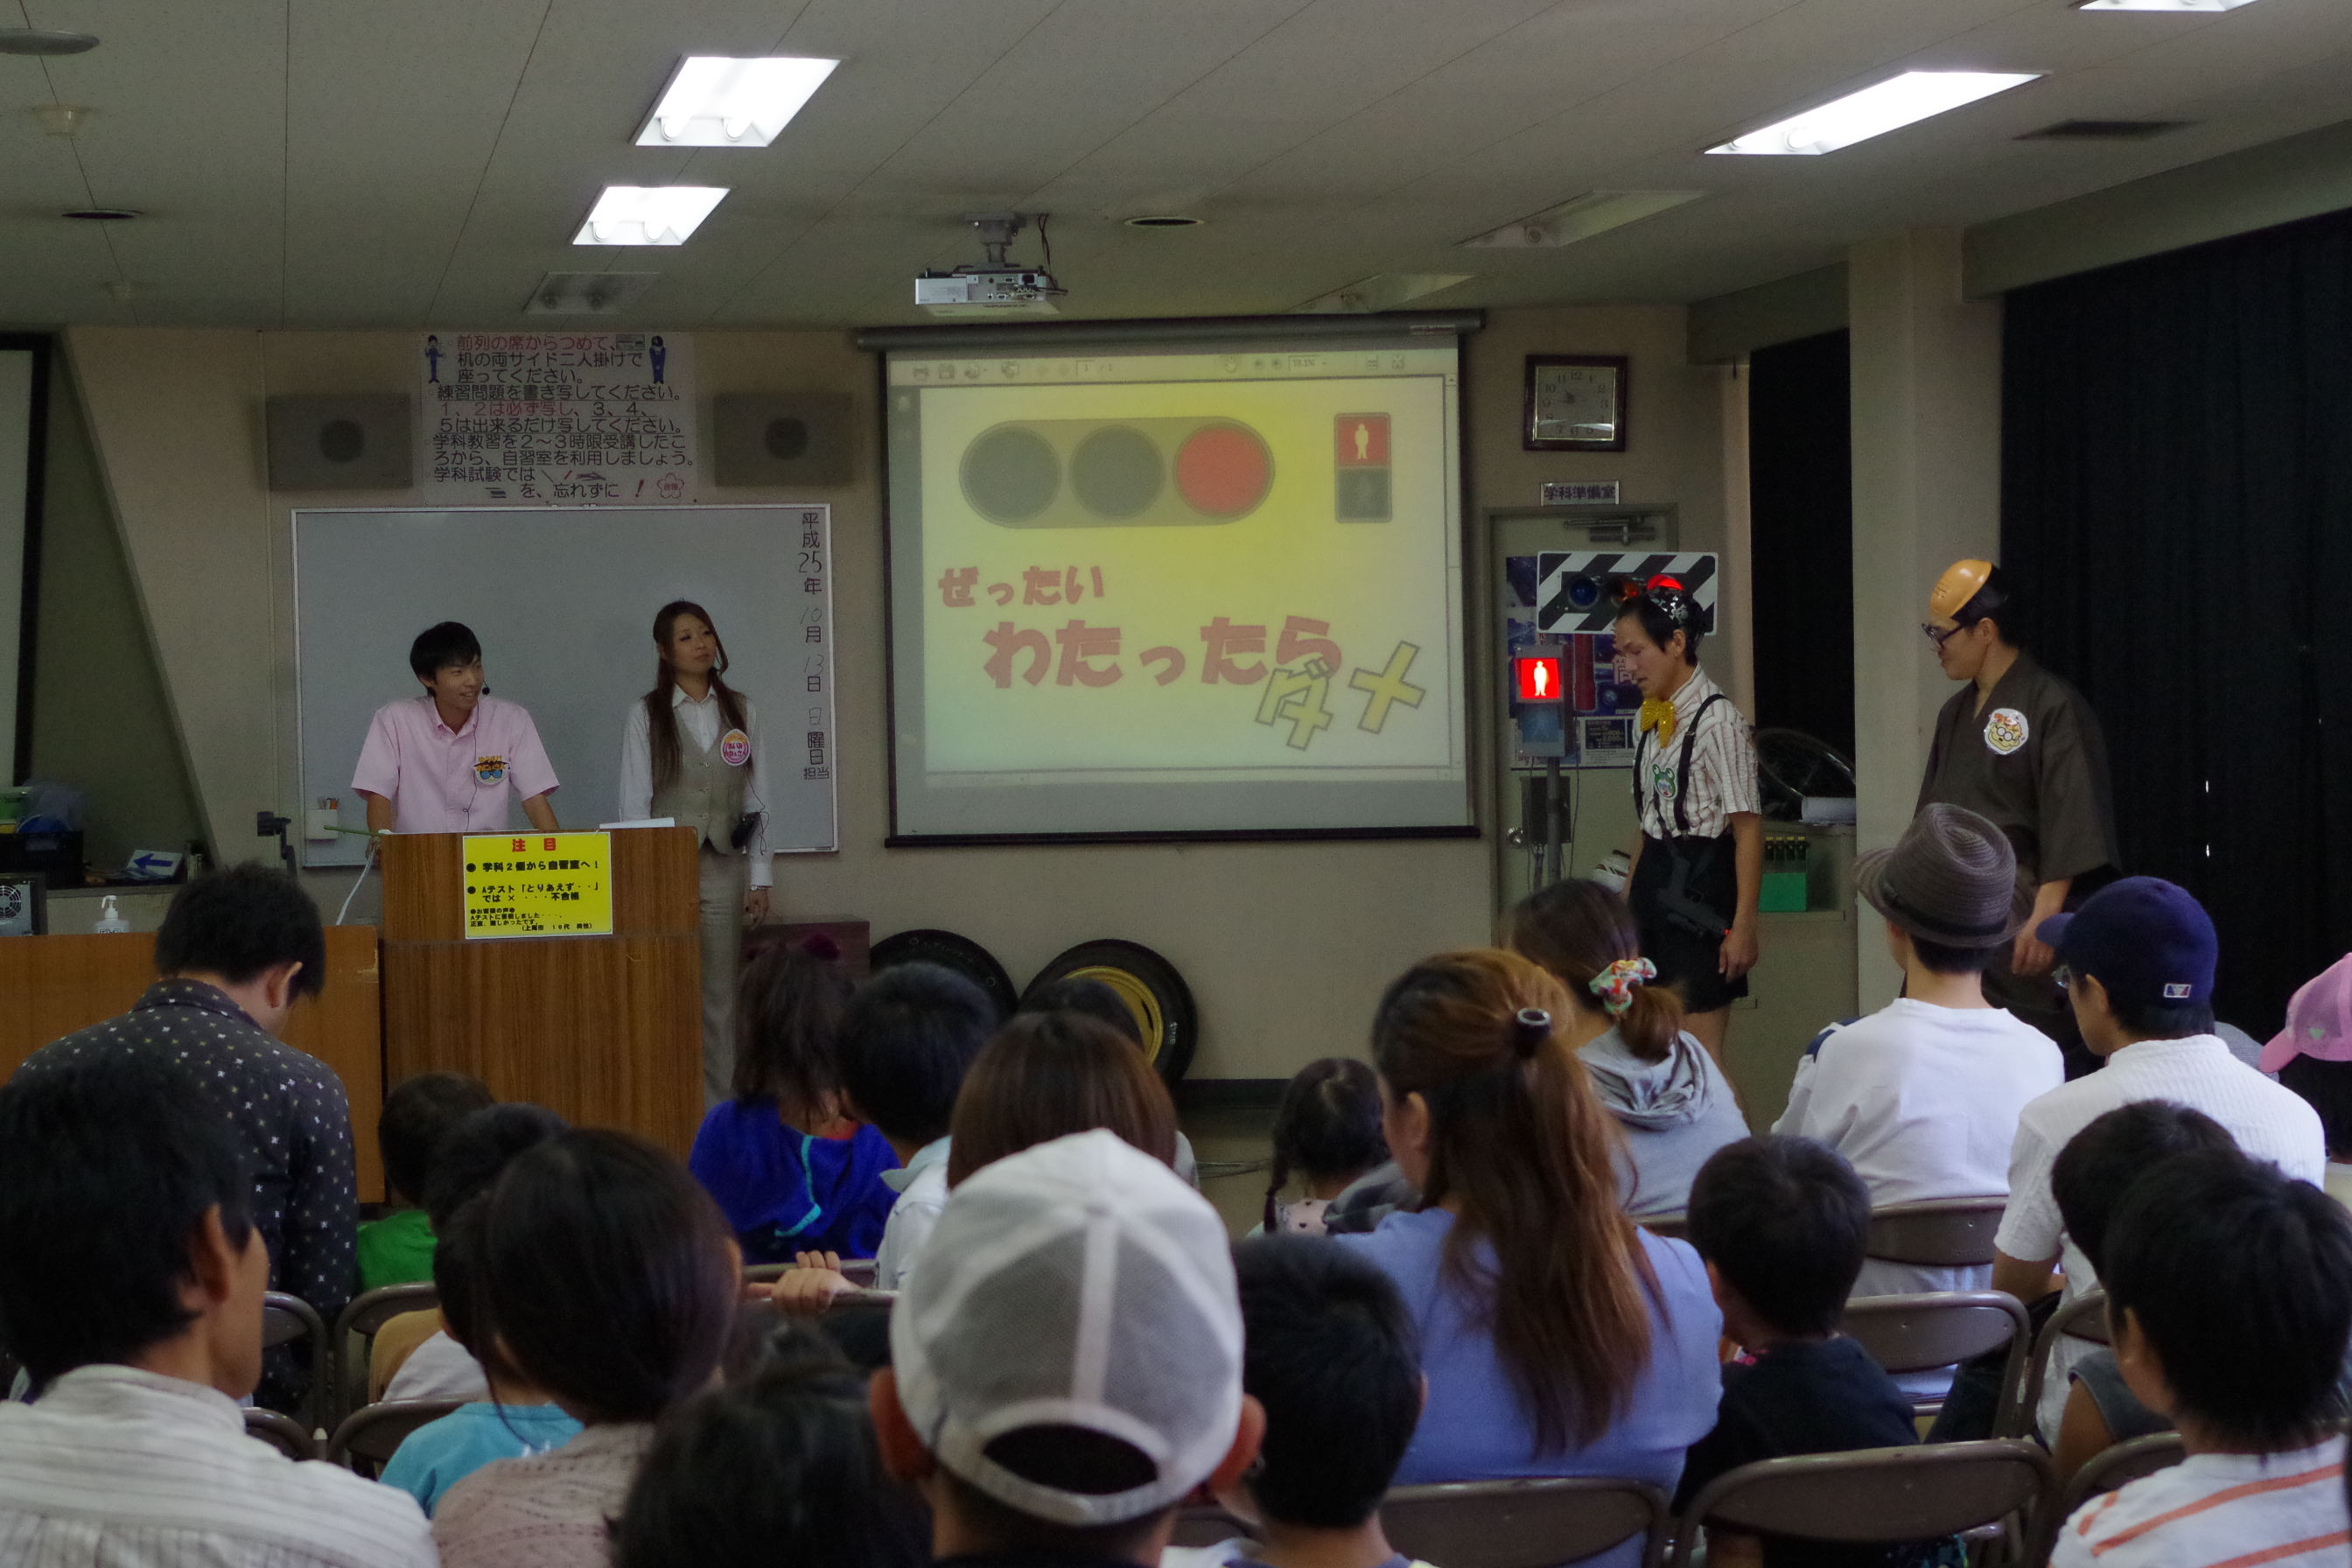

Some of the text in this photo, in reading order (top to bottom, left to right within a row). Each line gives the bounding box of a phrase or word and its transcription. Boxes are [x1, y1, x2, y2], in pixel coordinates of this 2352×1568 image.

[457, 334, 615, 350] 前列の席からつめて、
[458, 368, 583, 383] 座ってください。
[1571, 372, 1582, 381] 12
[437, 384, 680, 400] 練習問題を書き写してください。
[1545, 383, 1556, 393] 10
[1600, 399, 1608, 409] 3
[440, 417, 681, 433] 5は出来るだけ写してください。
[434, 450, 693, 466] ろから、自習室を利用しましょう。
[434, 466, 536, 482] 学科試験では
[520, 483, 620, 499] を、忘れずに
[1544, 486, 1616, 500] 学科準備室
[938, 565, 1105, 608] ぜったい
[982, 615, 1342, 690] わたったら
[803, 766, 830, 780] 担当
